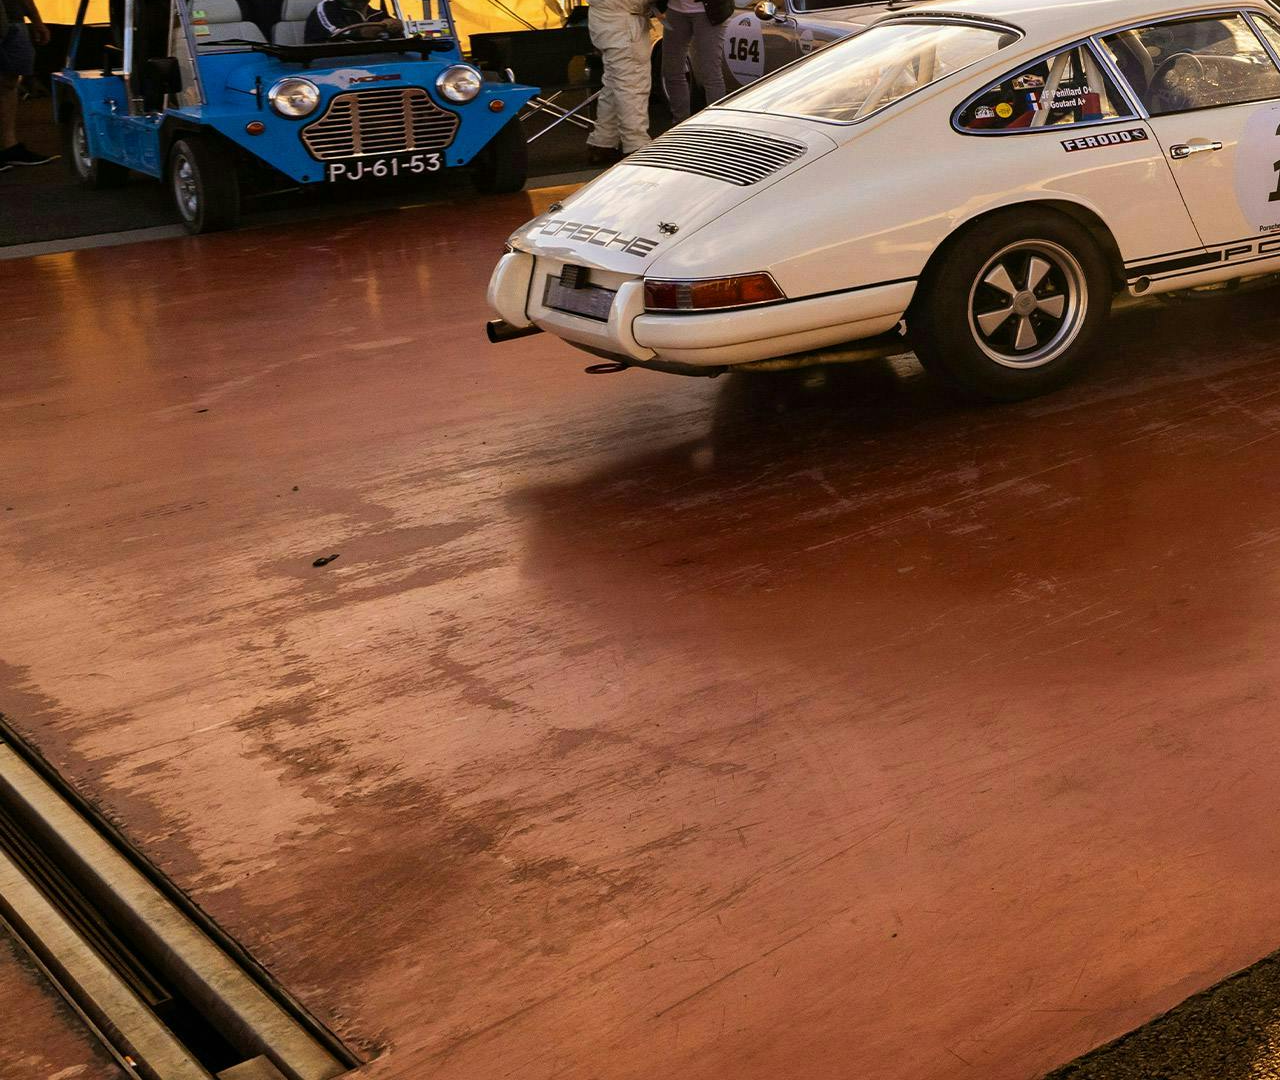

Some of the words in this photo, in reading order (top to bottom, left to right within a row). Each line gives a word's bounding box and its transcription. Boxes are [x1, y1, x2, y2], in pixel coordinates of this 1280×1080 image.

[729, 37, 760, 62] 164
[1052, 87, 1082, 98] Penillard
[1050, 98, 1076, 109] Goutard
[1064, 131, 1132, 151] FERODO
[329, 153, 440, 182] PJ-61-53
[1260, 222, 1280, 232] Porsche
